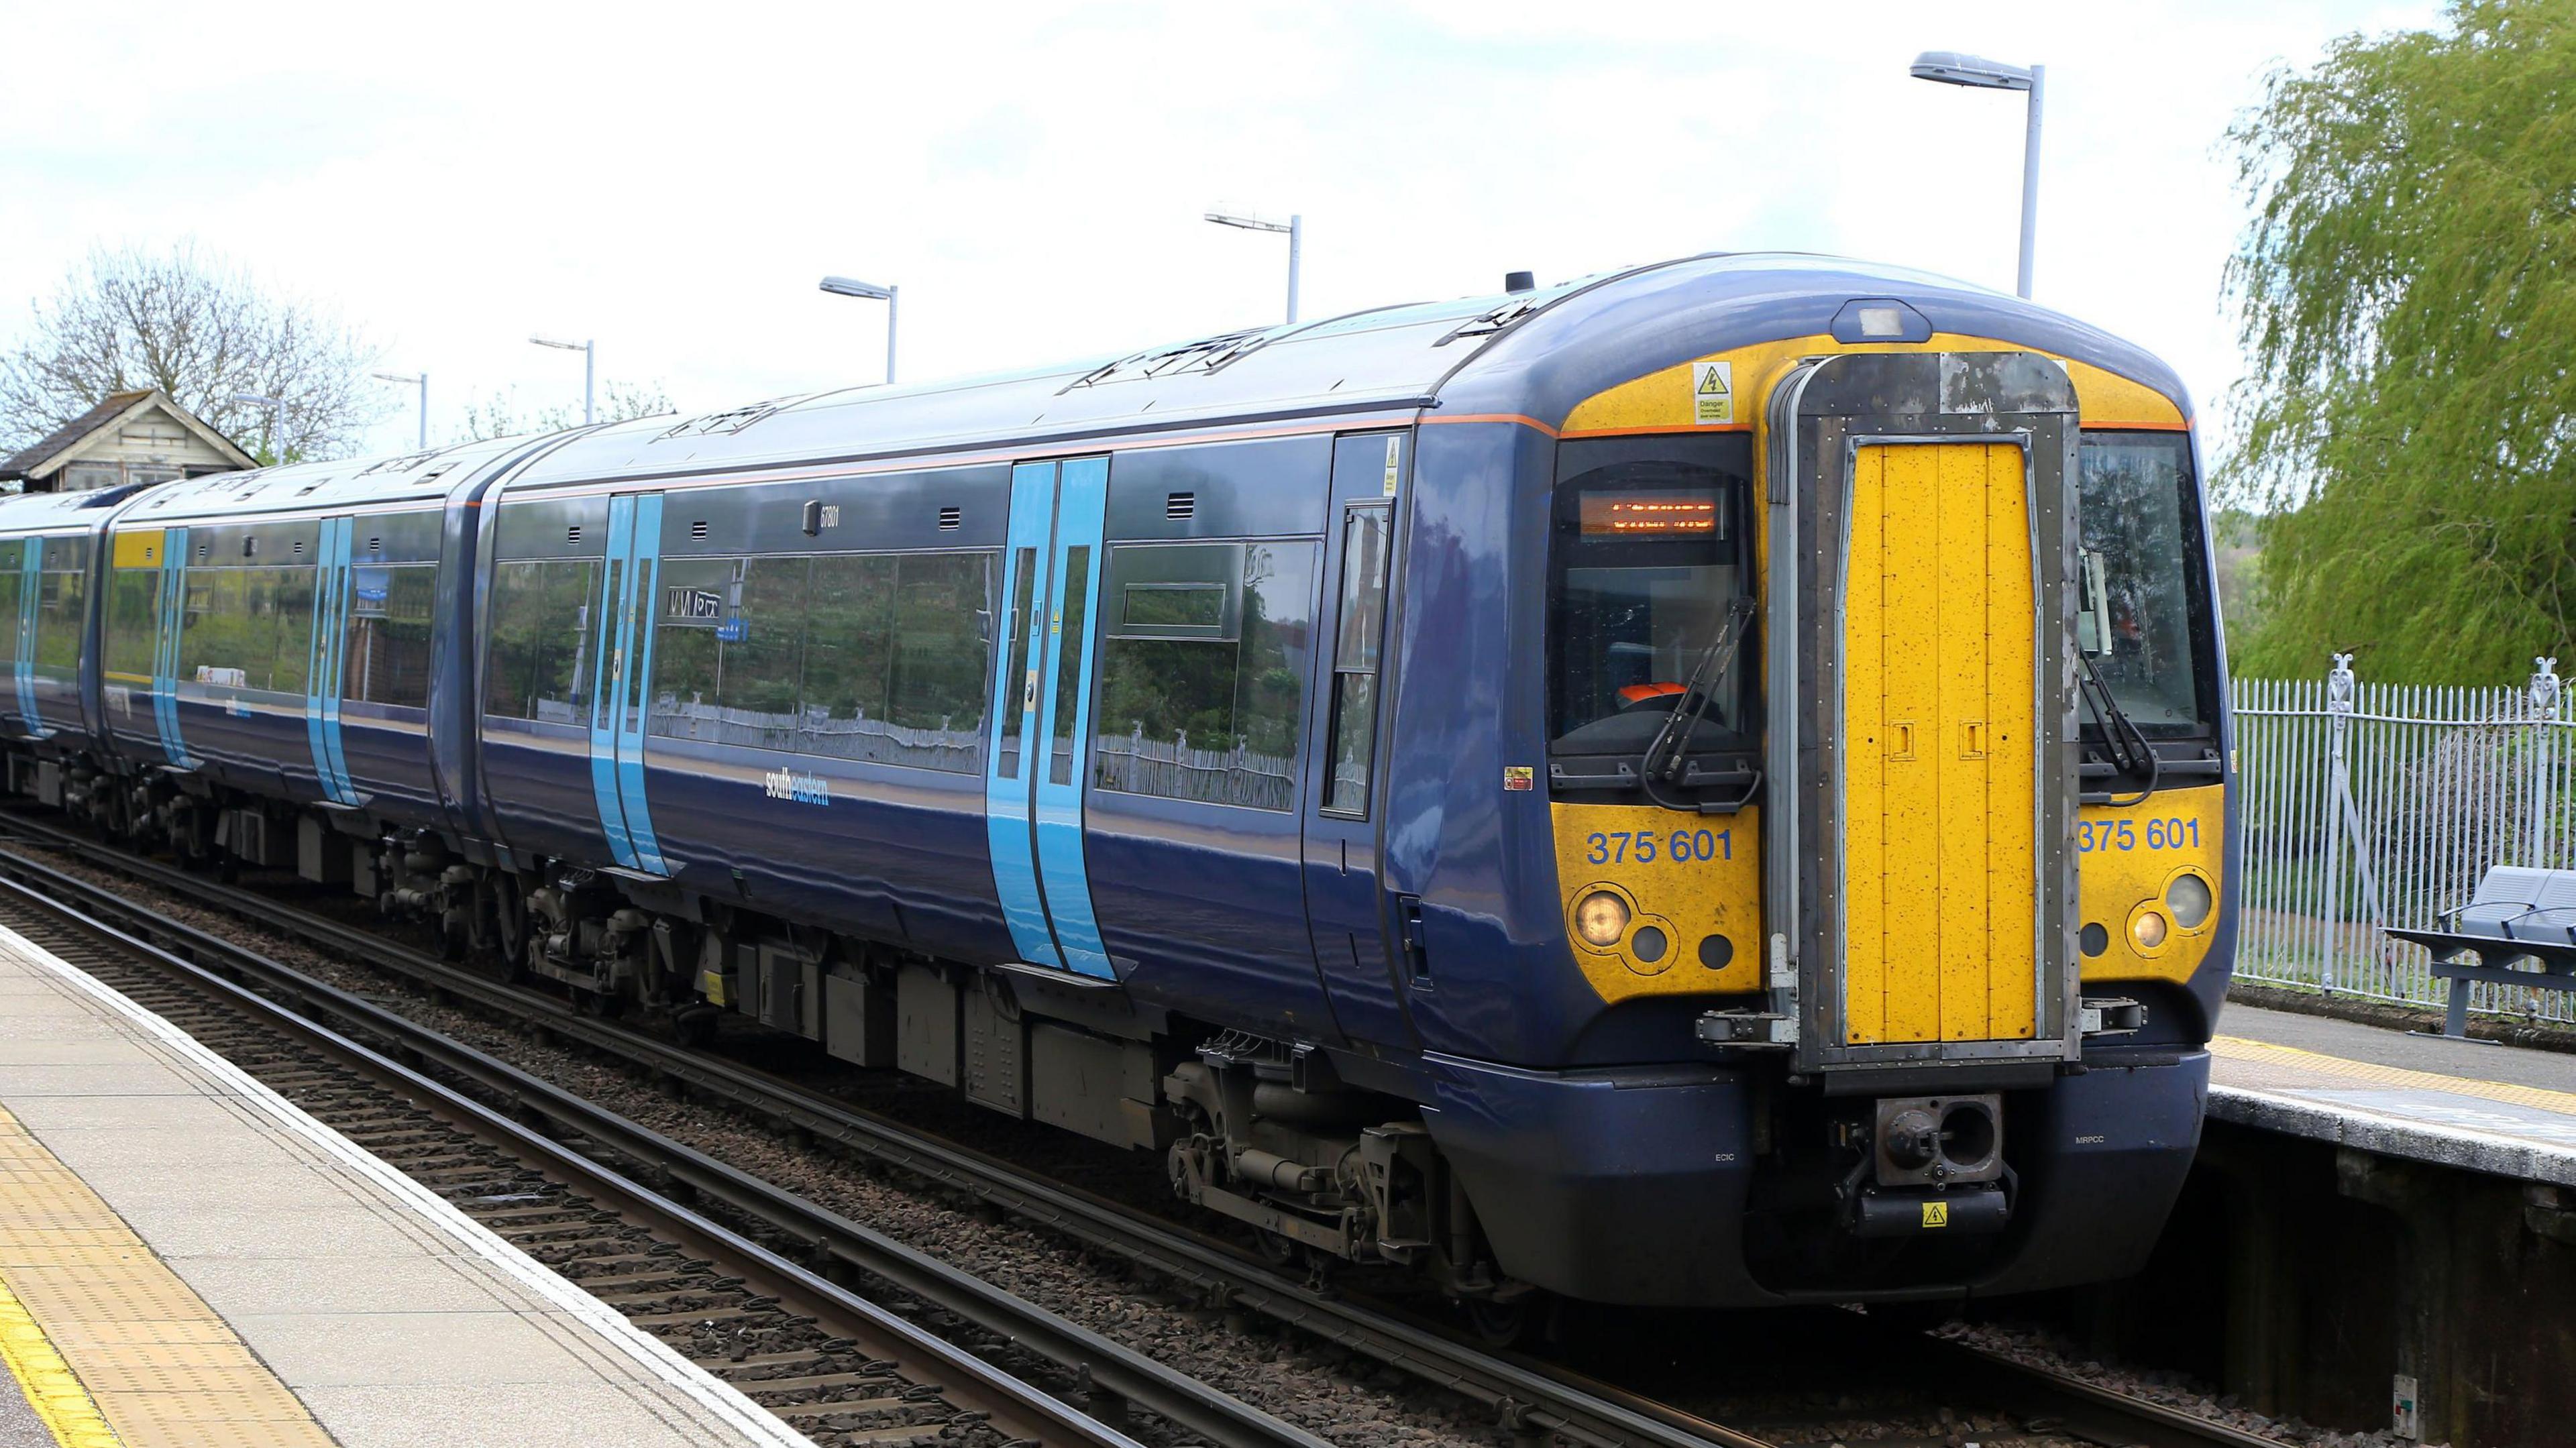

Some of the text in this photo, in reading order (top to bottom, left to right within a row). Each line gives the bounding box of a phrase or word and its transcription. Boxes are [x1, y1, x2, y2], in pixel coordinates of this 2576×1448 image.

[820, 505, 839, 528] 67801
[766, 767, 829, 806] southeastern
[1587, 829, 1731, 865] 375 601
[2078, 817, 2200, 852] 375 601
[2075, 1135, 2104, 1144] MRPCC
[1715, 1153, 1735, 1162] ECIC
